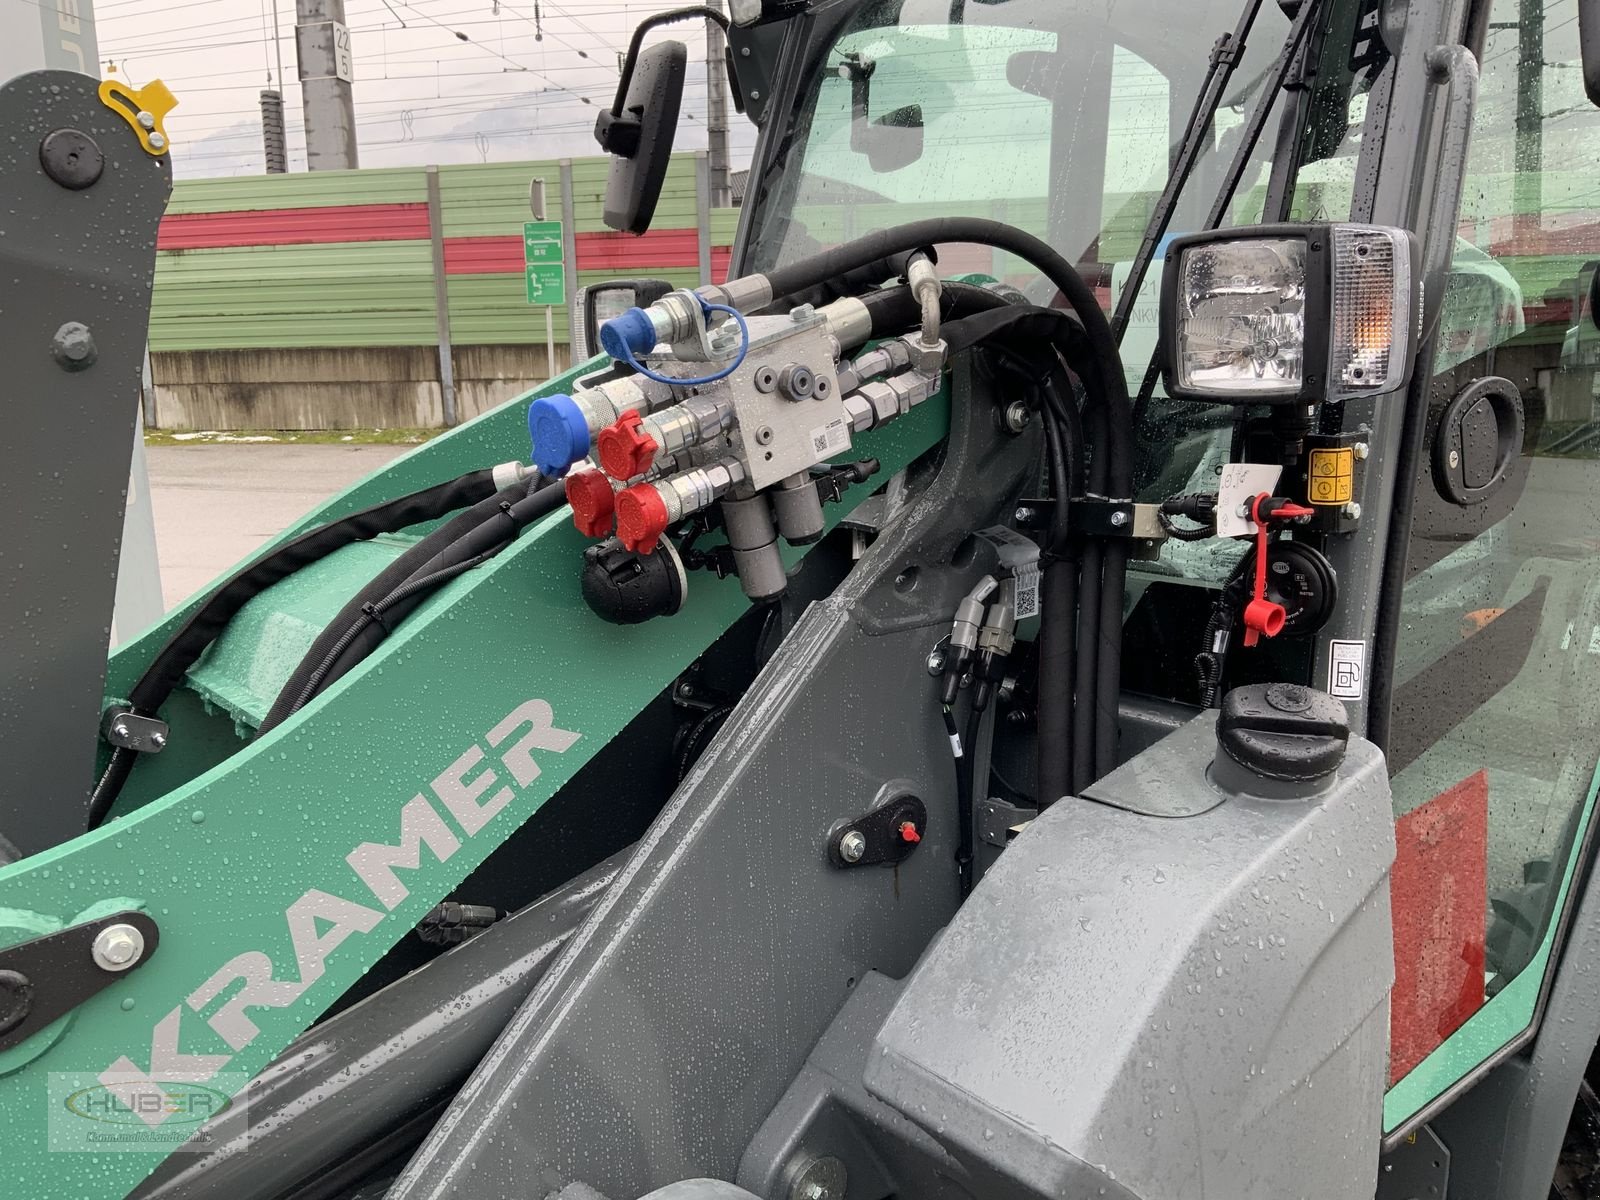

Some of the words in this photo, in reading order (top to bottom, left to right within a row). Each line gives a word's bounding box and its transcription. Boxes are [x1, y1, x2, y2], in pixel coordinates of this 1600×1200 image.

[336, 28, 349, 51] 22
[342, 55, 348, 75] 5
[97, 698, 583, 1129] KRAMER
